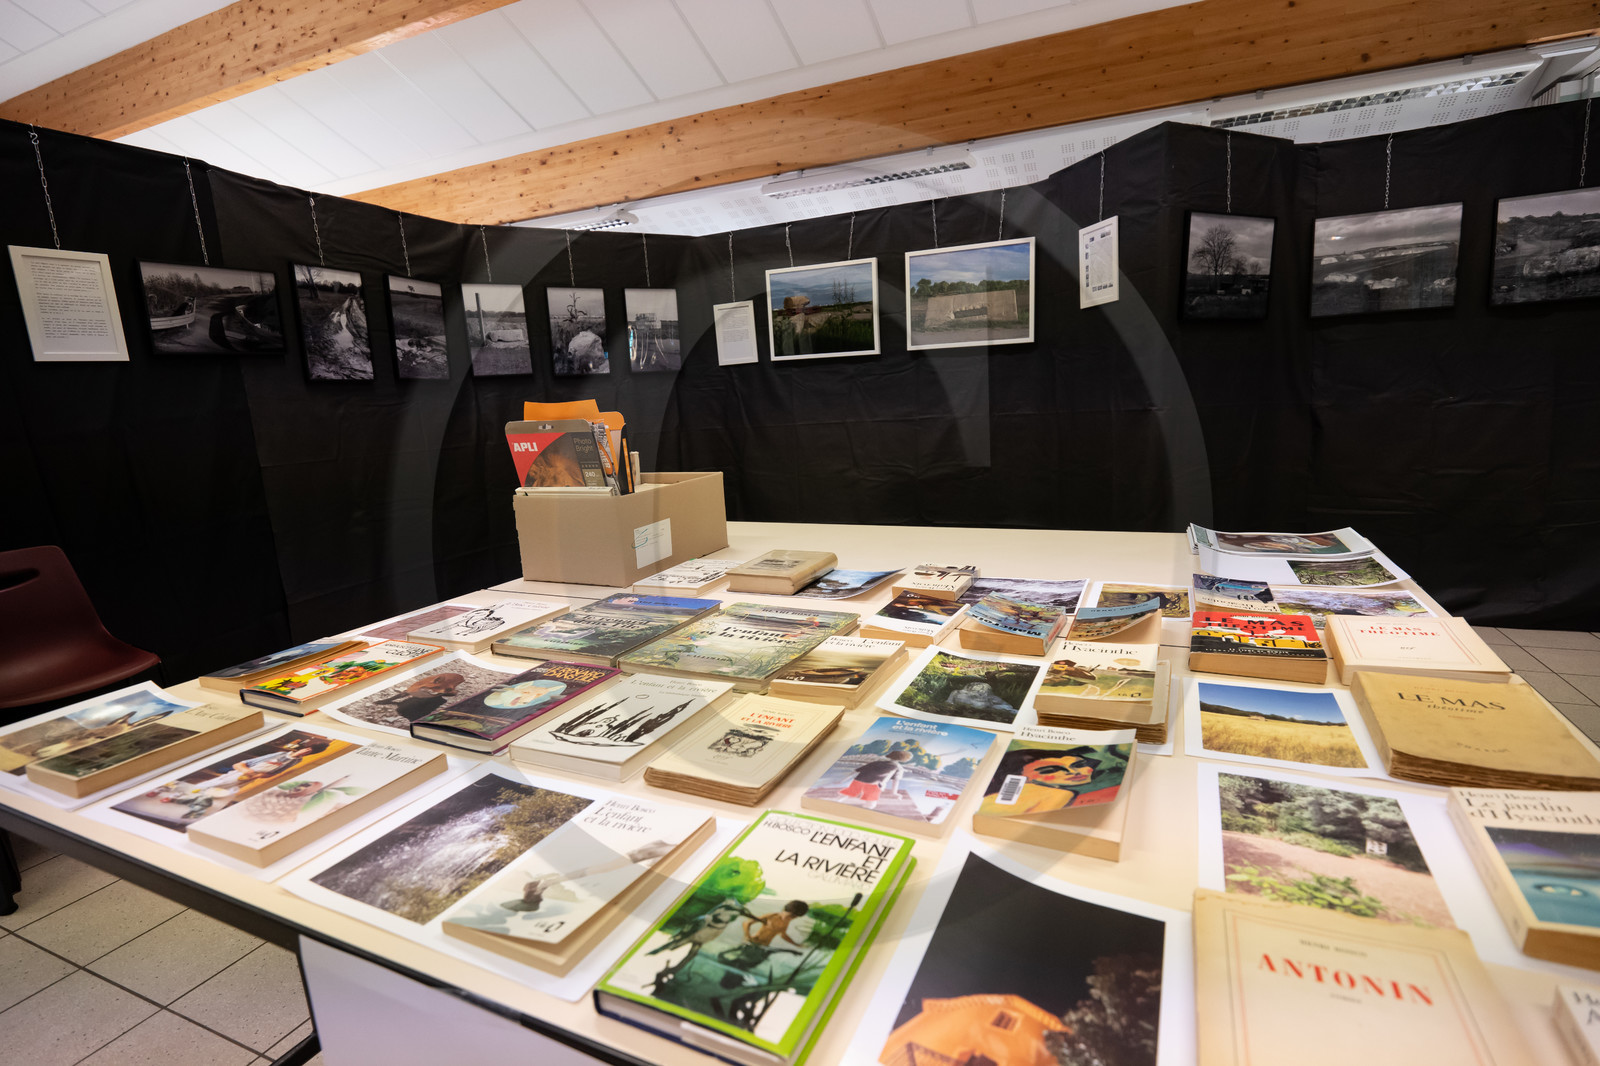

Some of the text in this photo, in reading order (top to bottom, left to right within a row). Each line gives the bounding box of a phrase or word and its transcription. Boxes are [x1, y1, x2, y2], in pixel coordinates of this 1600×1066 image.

[513, 442, 538, 452] APLI
[575, 445, 593, 454] Bright
[972, 613, 1042, 636] Malicroix
[739, 634, 797, 645] rivière
[862, 638, 901, 646] L'enfant
[1062, 645, 1138, 655] Hyacinthe
[631, 680, 664, 688] L'enfant
[1398, 692, 1506, 710] LE MAS
[750, 712, 795, 723] L'ENFANT
[896, 720, 938, 730] L'enfant
[1022, 726, 1046, 734] Henri
[915, 728, 948, 736] rivière
[1020, 731, 1076, 742] Hyacinthe
[356, 747, 422, 764] Tante Martine
[606, 800, 656, 813] Henri Bosco
[1466, 798, 1573, 813] Le jardin
[594, 807, 643, 822] L'enfant
[584, 816, 652, 833] et la rivière
[809, 831, 895, 858] L'ENFANT
[775, 849, 880, 884] LA RIVIÈRE
[862, 856, 888, 870] ET
[1258, 953, 1434, 1006] ANTONIN
